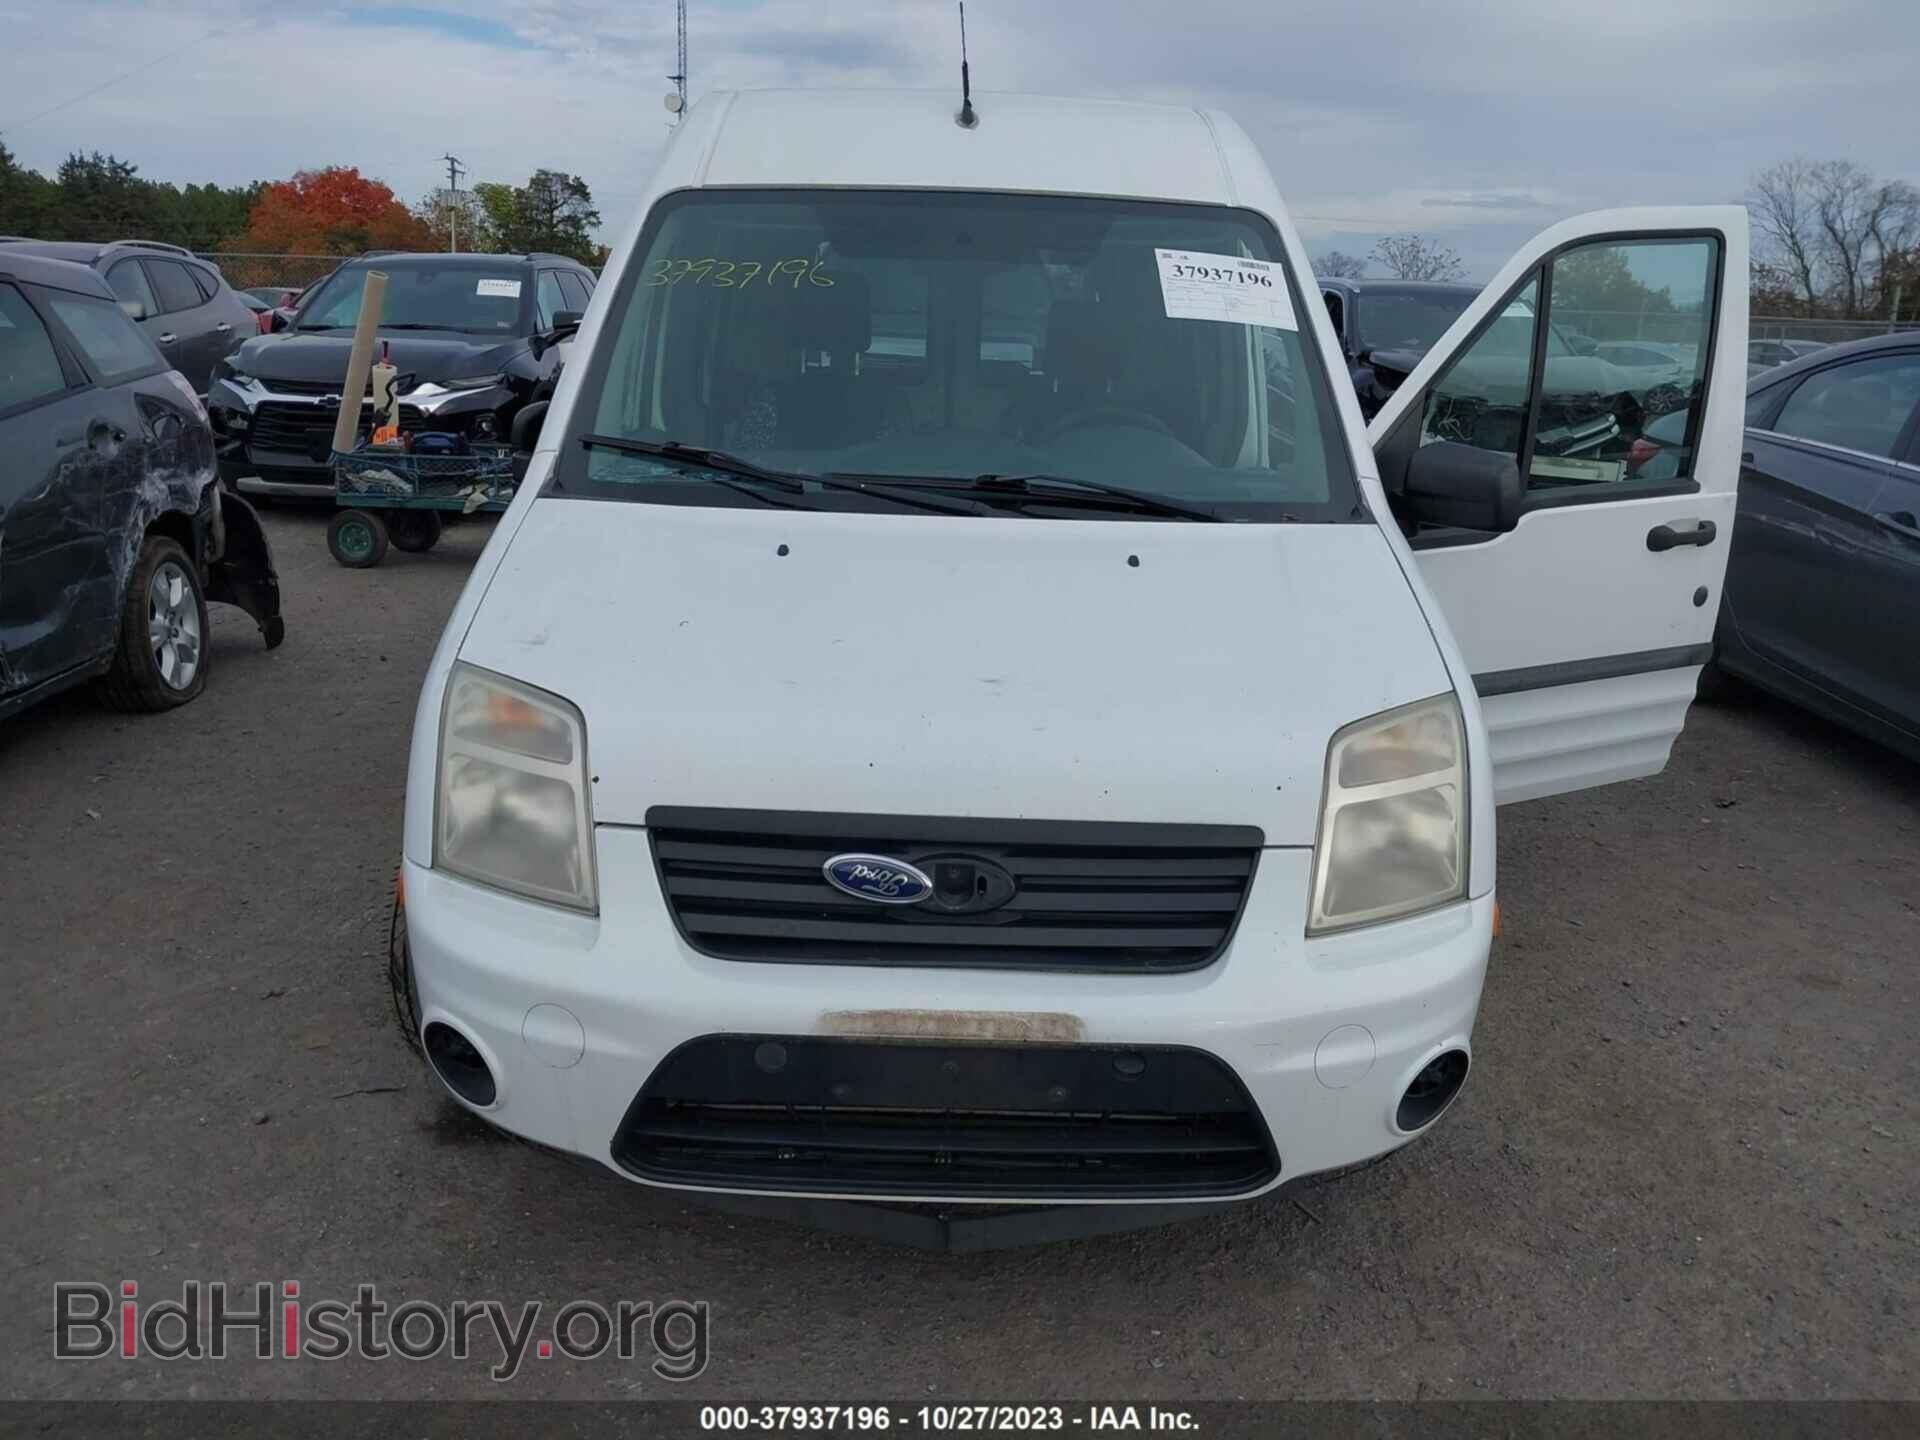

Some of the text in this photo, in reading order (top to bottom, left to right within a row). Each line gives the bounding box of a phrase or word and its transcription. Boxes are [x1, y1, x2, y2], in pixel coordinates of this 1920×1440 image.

[648, 258, 836, 289] 37937196
[1172, 264, 1272, 288] 37937196
[849, 863, 909, 896] Ford
